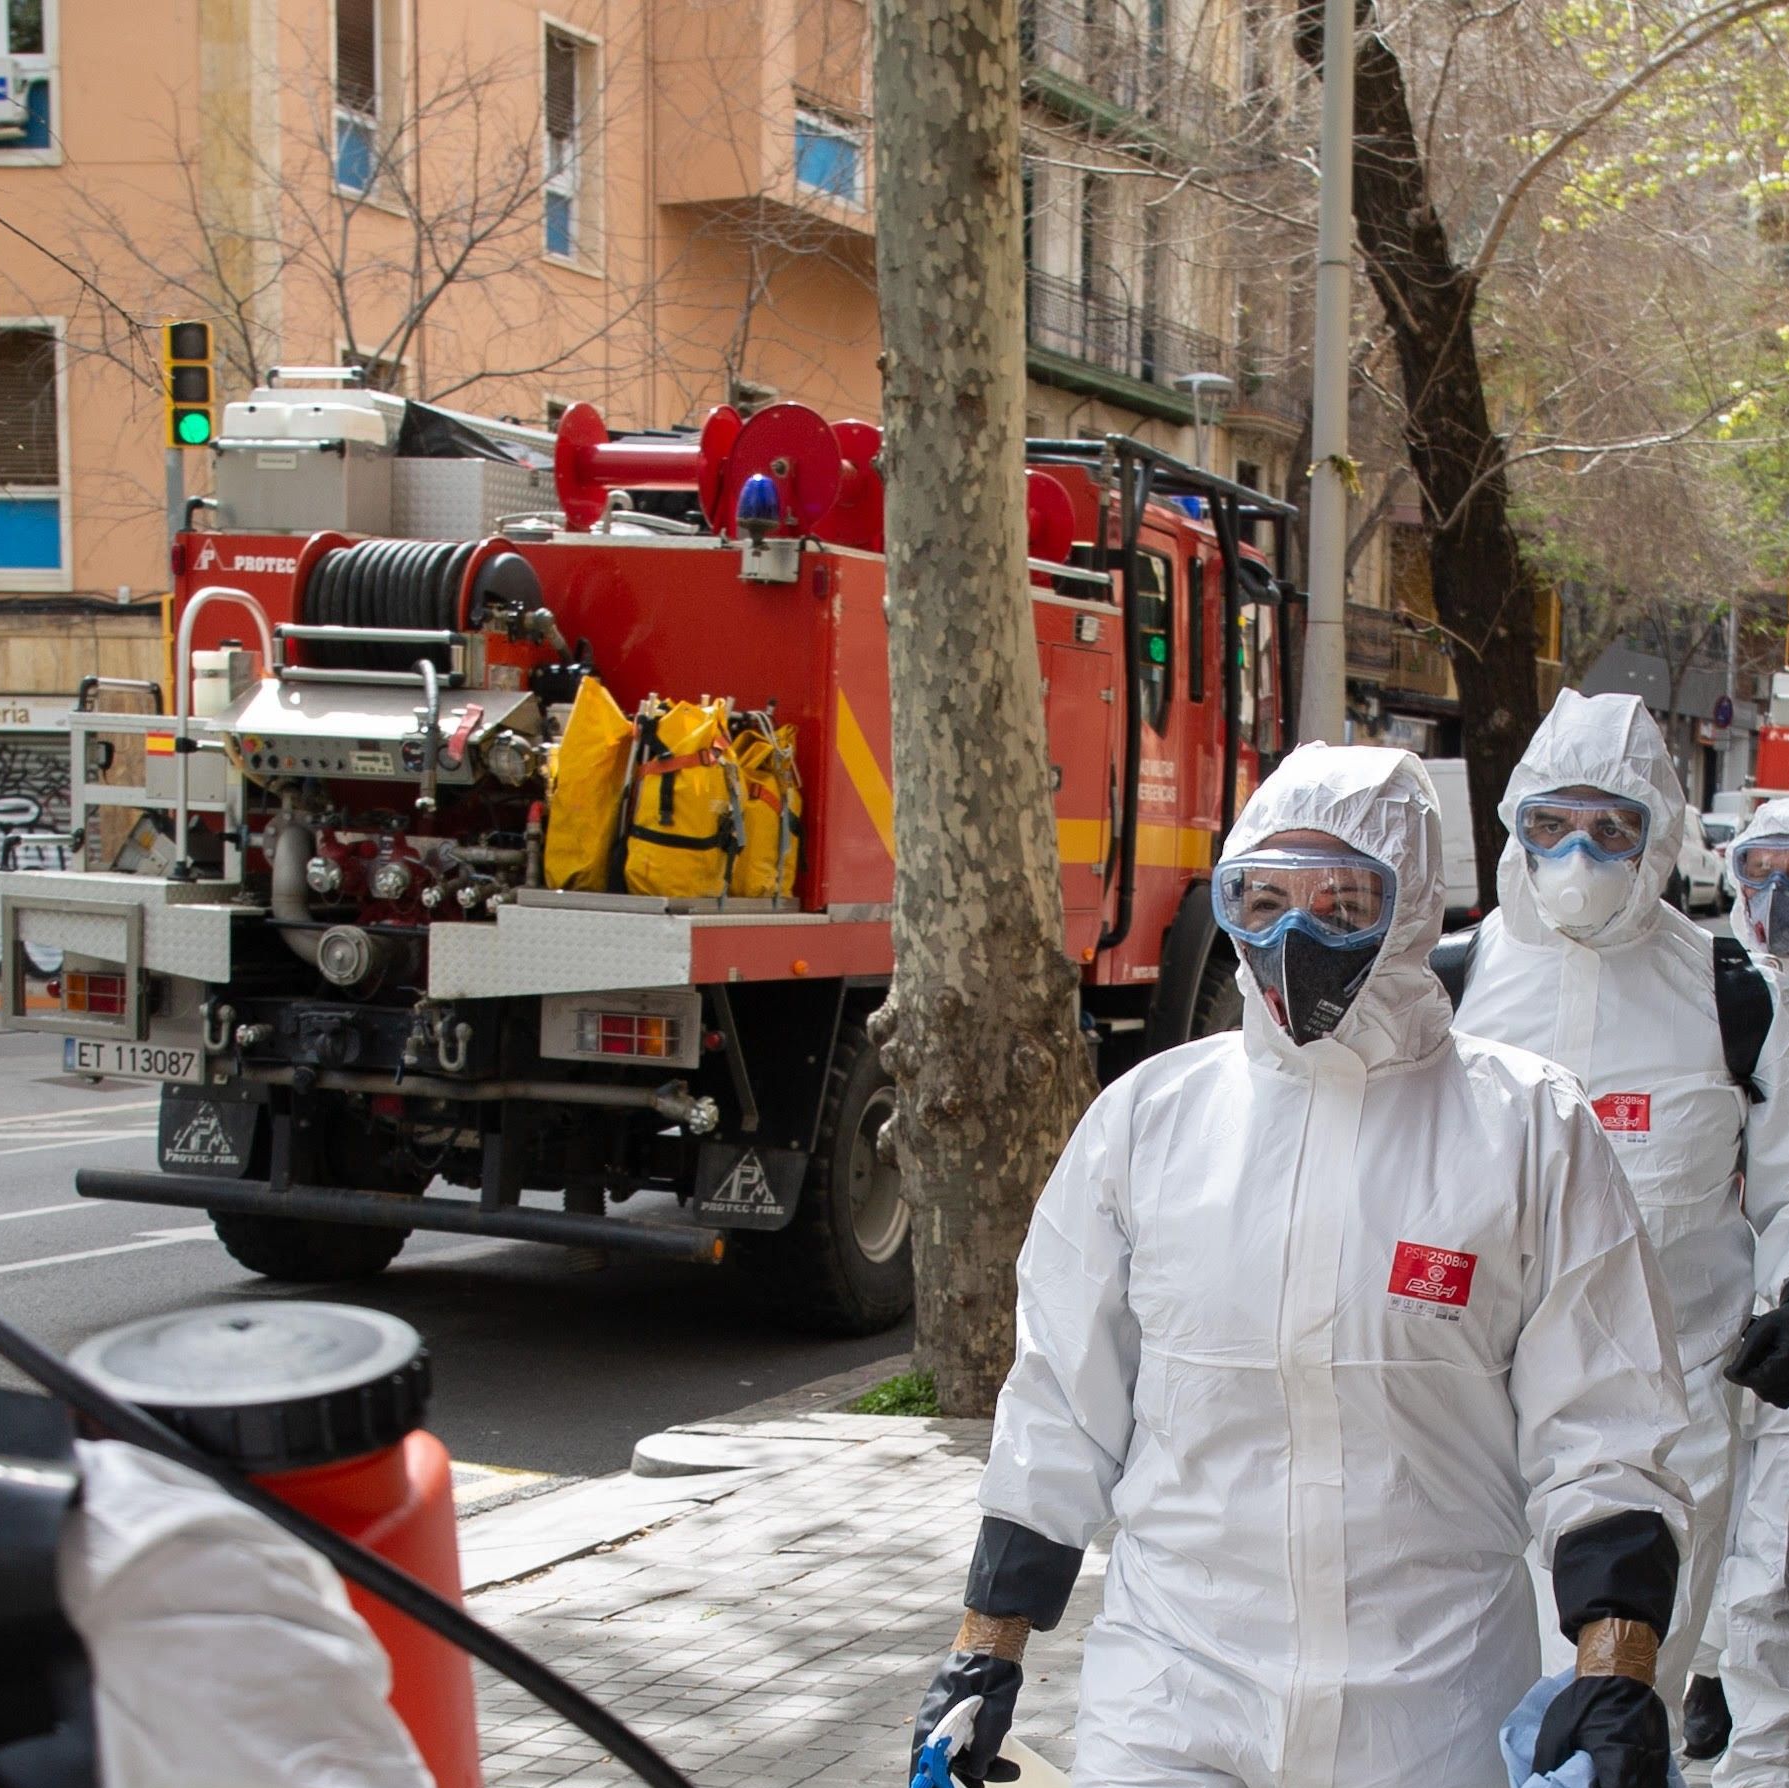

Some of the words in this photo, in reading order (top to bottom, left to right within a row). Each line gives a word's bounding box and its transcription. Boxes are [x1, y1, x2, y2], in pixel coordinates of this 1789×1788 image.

[78, 1042, 105, 1069] ET
[116, 1045, 195, 1078] 113087
[1404, 1246, 1469, 1269] PSH250Bio
[1405, 1278, 1457, 1298] PSH
